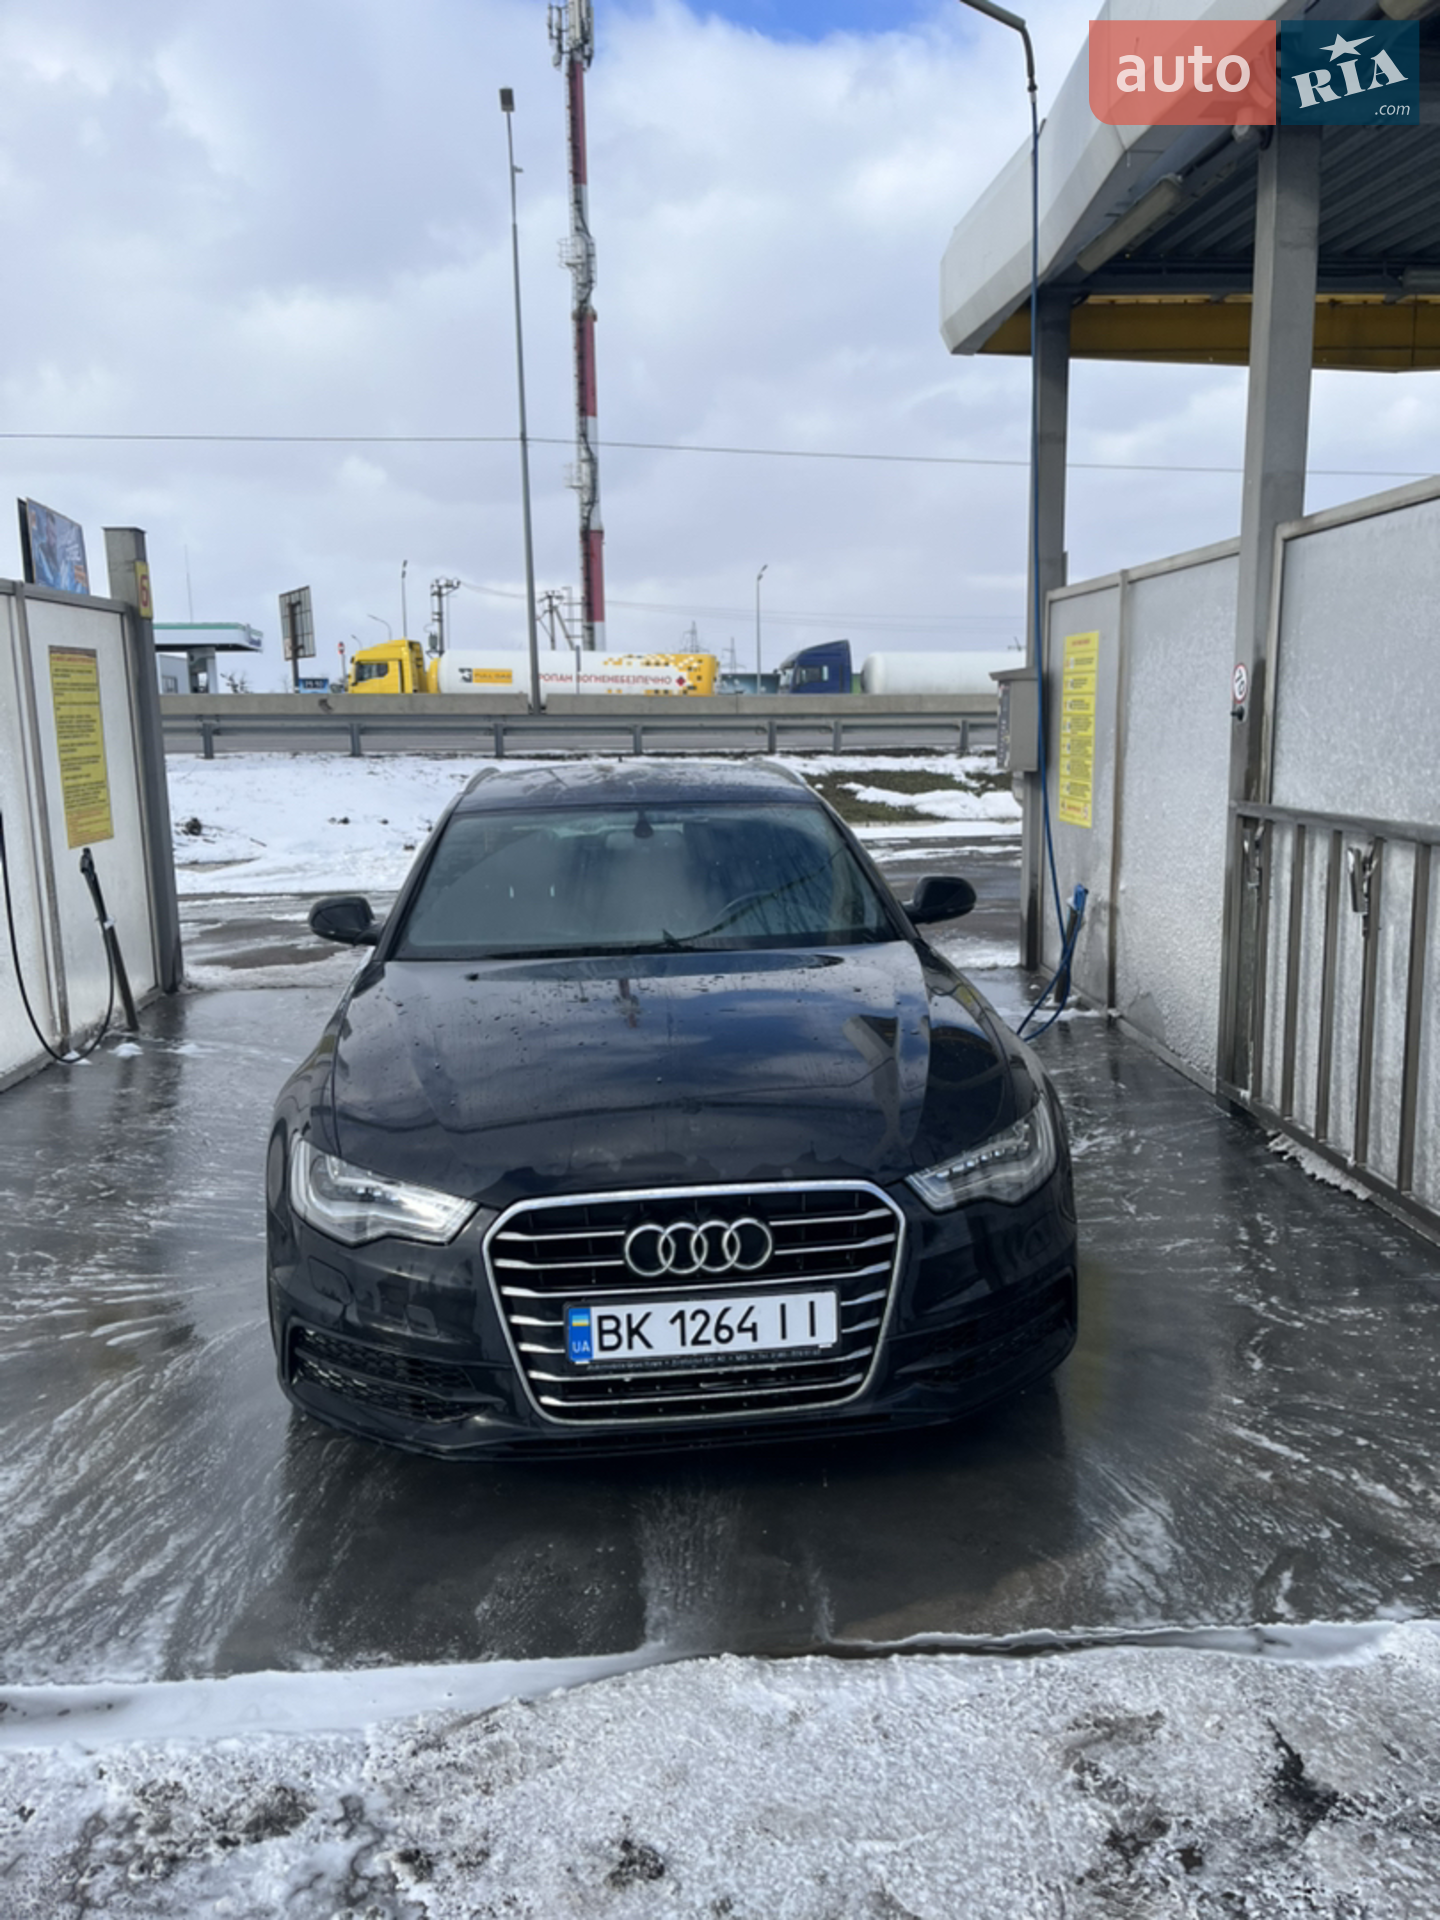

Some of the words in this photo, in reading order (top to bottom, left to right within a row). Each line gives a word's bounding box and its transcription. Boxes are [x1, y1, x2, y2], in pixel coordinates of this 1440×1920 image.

[537, 673, 573, 683] РОПАН
[597, 1312, 654, 1352] BK
[669, 1305, 758, 1347] 1264
[571, 1341, 591, 1354] UA
